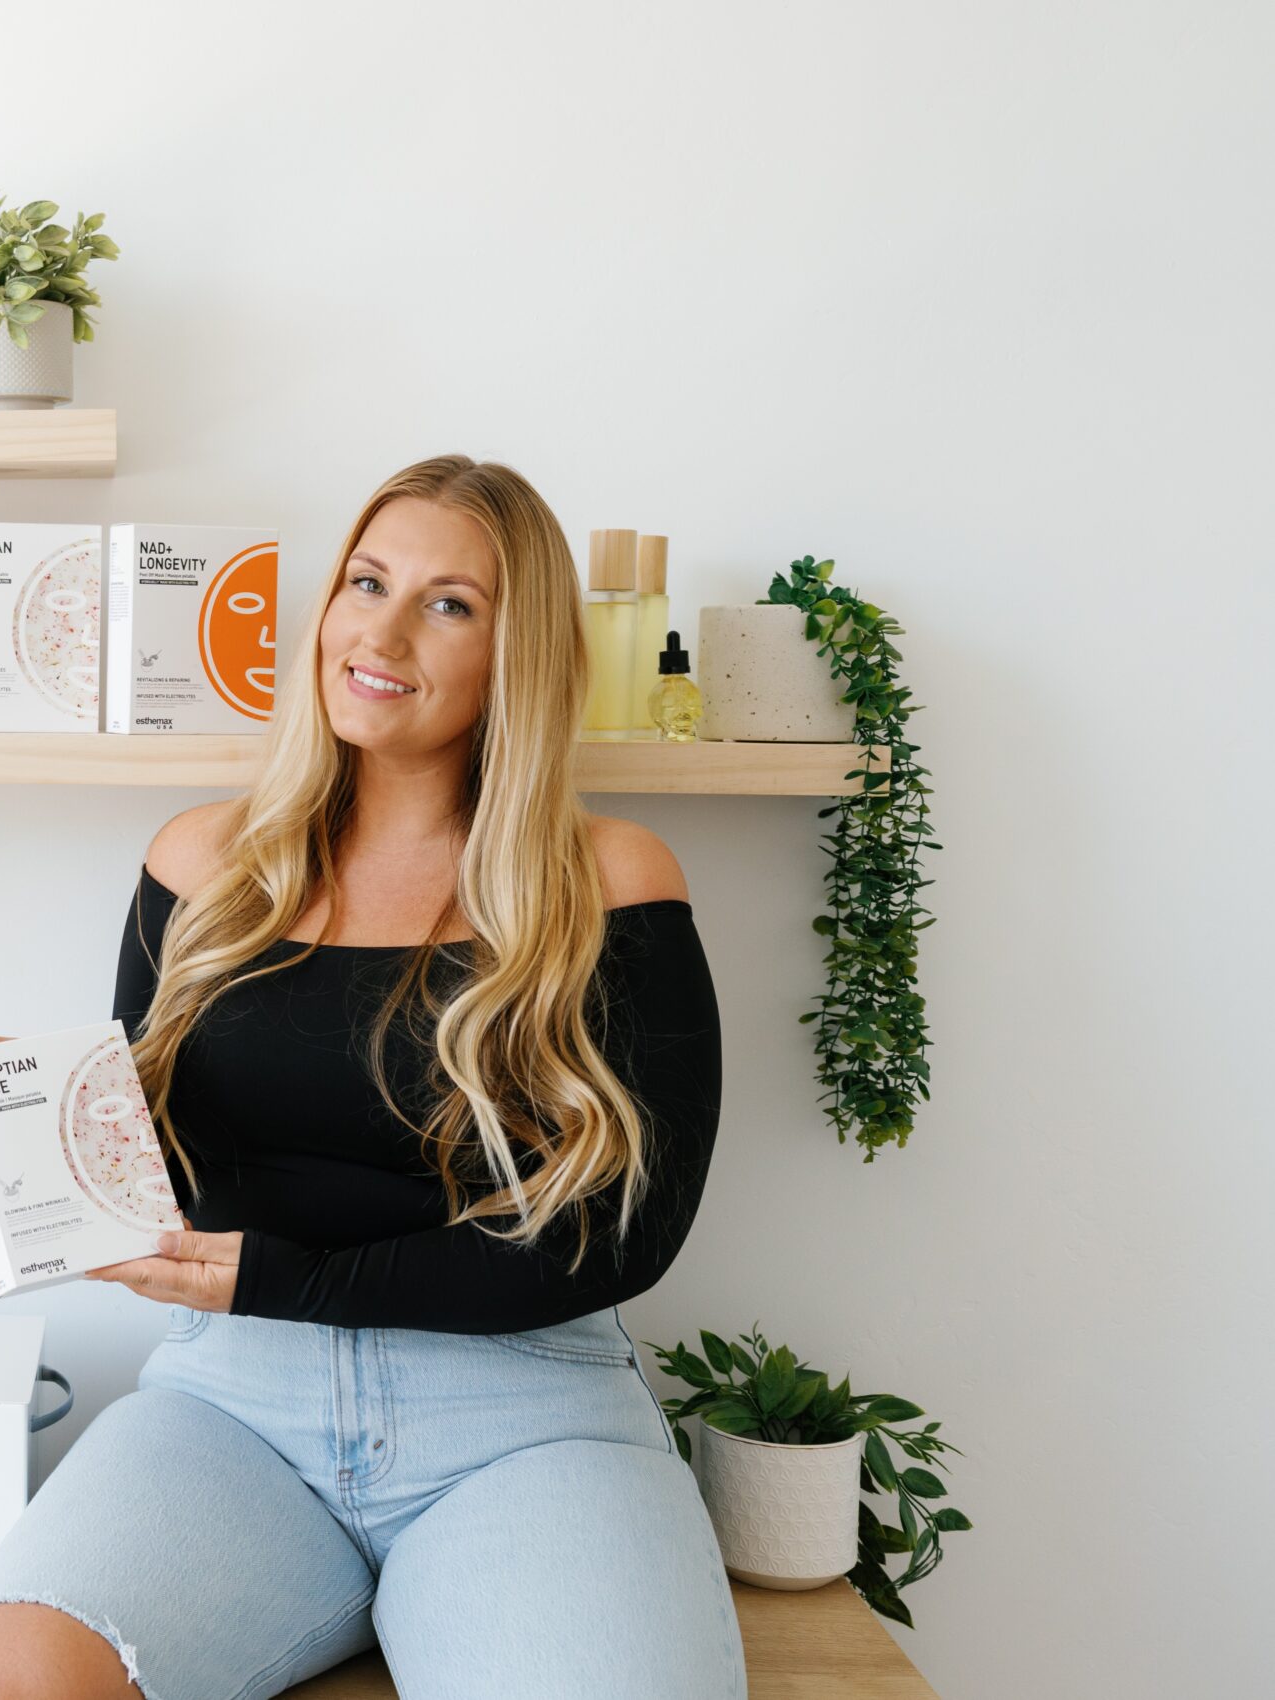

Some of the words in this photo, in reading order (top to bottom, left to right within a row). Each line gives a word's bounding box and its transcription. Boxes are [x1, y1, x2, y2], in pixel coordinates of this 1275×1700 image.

[140, 542, 172, 554] NAD+
[140, 558, 206, 571] LONGEVITY
[136, 717, 172, 726] esthemax
[5, 1207, 27, 1215] GLOWING
[45, 1197, 71, 1206] WRINKLES
[47, 1218, 82, 1230] ELECTROLYTES
[21, 1257, 65, 1275] esthemax
